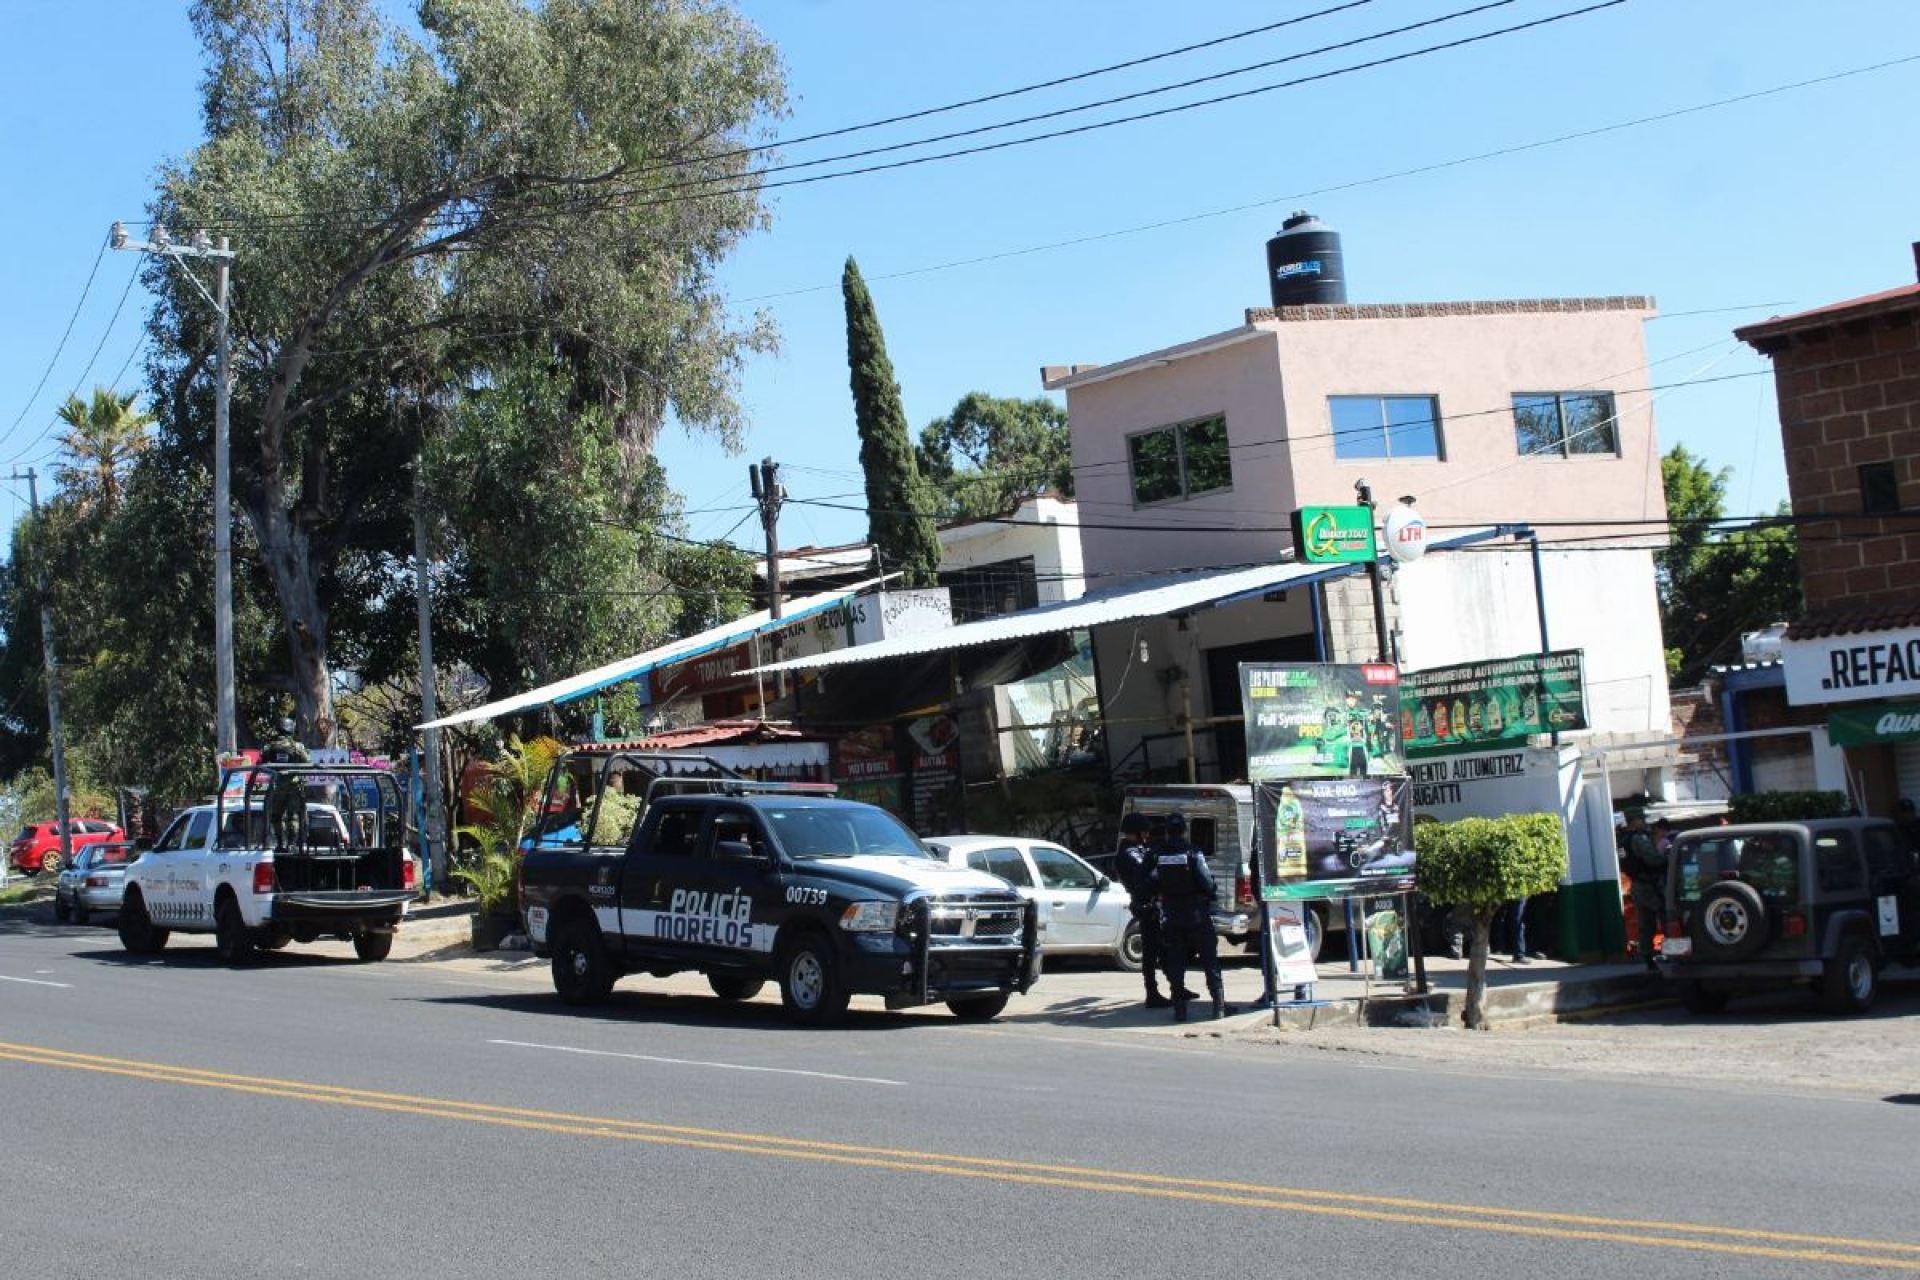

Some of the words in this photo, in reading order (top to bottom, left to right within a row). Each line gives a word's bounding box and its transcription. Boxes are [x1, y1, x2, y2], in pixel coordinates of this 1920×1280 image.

[1399, 526, 1422, 541] LTH
[1474, 660, 1534, 679] AUTOMOTRIZ
[1536, 654, 1578, 670] BUGATTI
[1257, 713, 1276, 726] Full
[1453, 753, 1524, 779] AUTOMOTRIZ
[1412, 783, 1462, 806] BUGATTI
[786, 886, 828, 905] 00739
[654, 914, 753, 948] MORELOS
